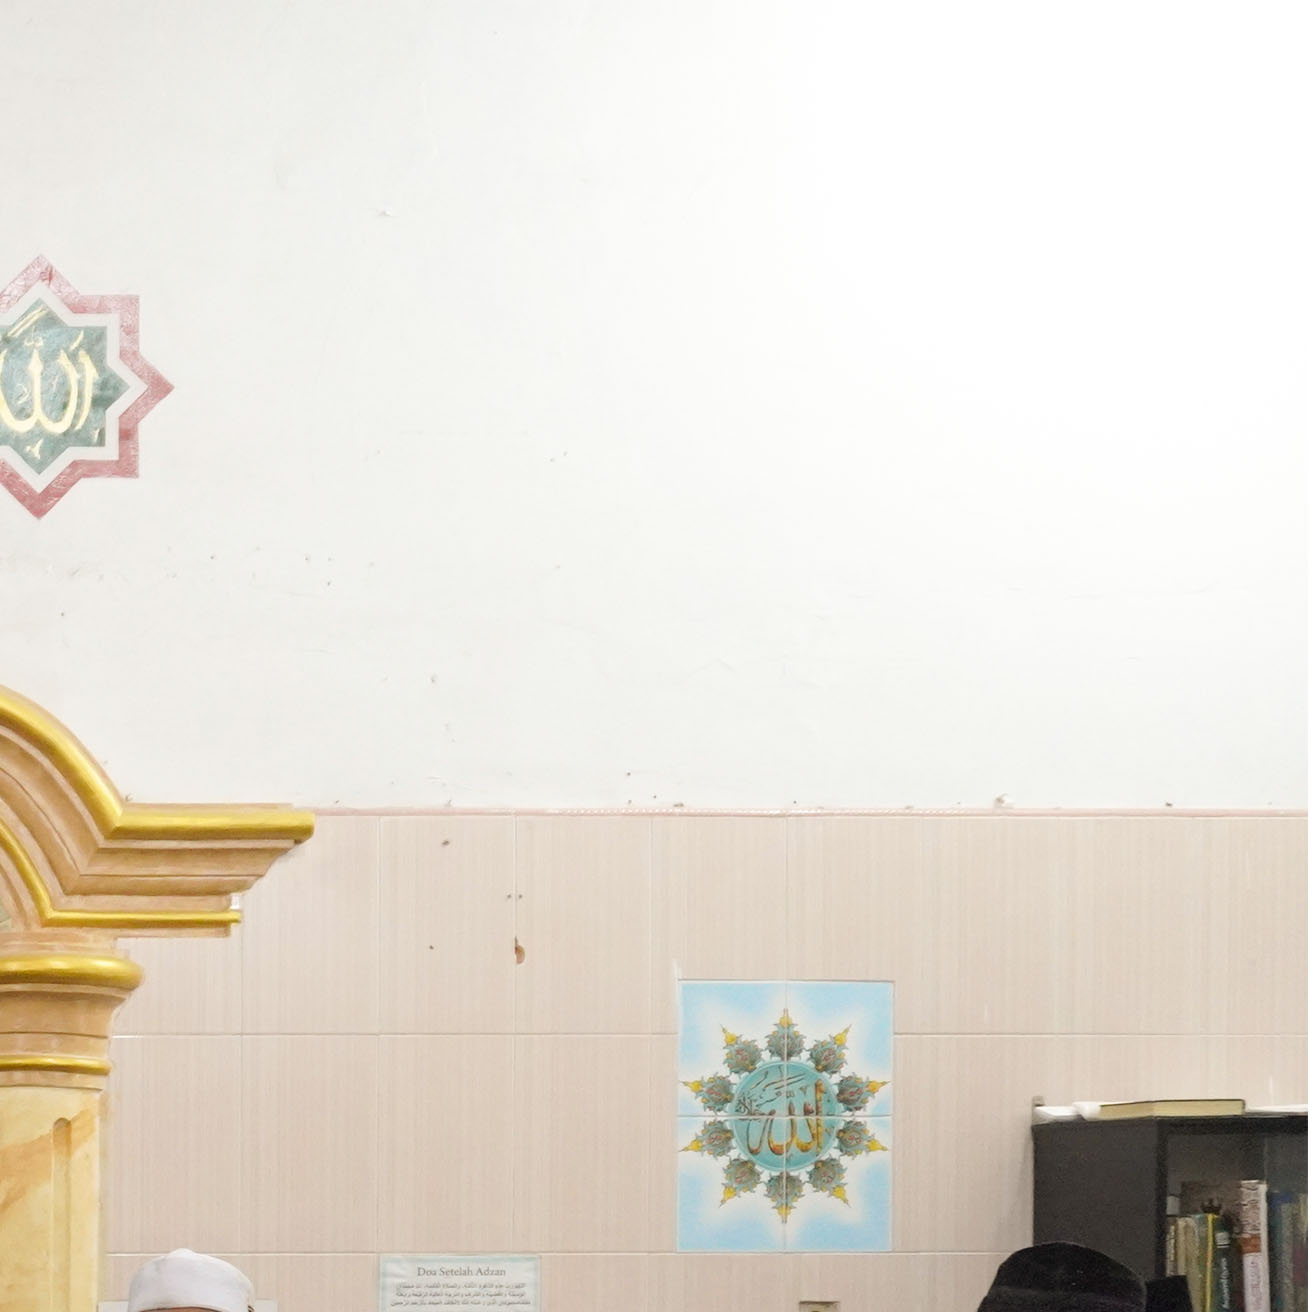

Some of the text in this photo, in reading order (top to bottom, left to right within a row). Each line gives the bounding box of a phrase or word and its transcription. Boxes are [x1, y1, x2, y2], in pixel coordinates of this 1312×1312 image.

[417, 1266, 507, 1277] Doa Setelah Adzan
